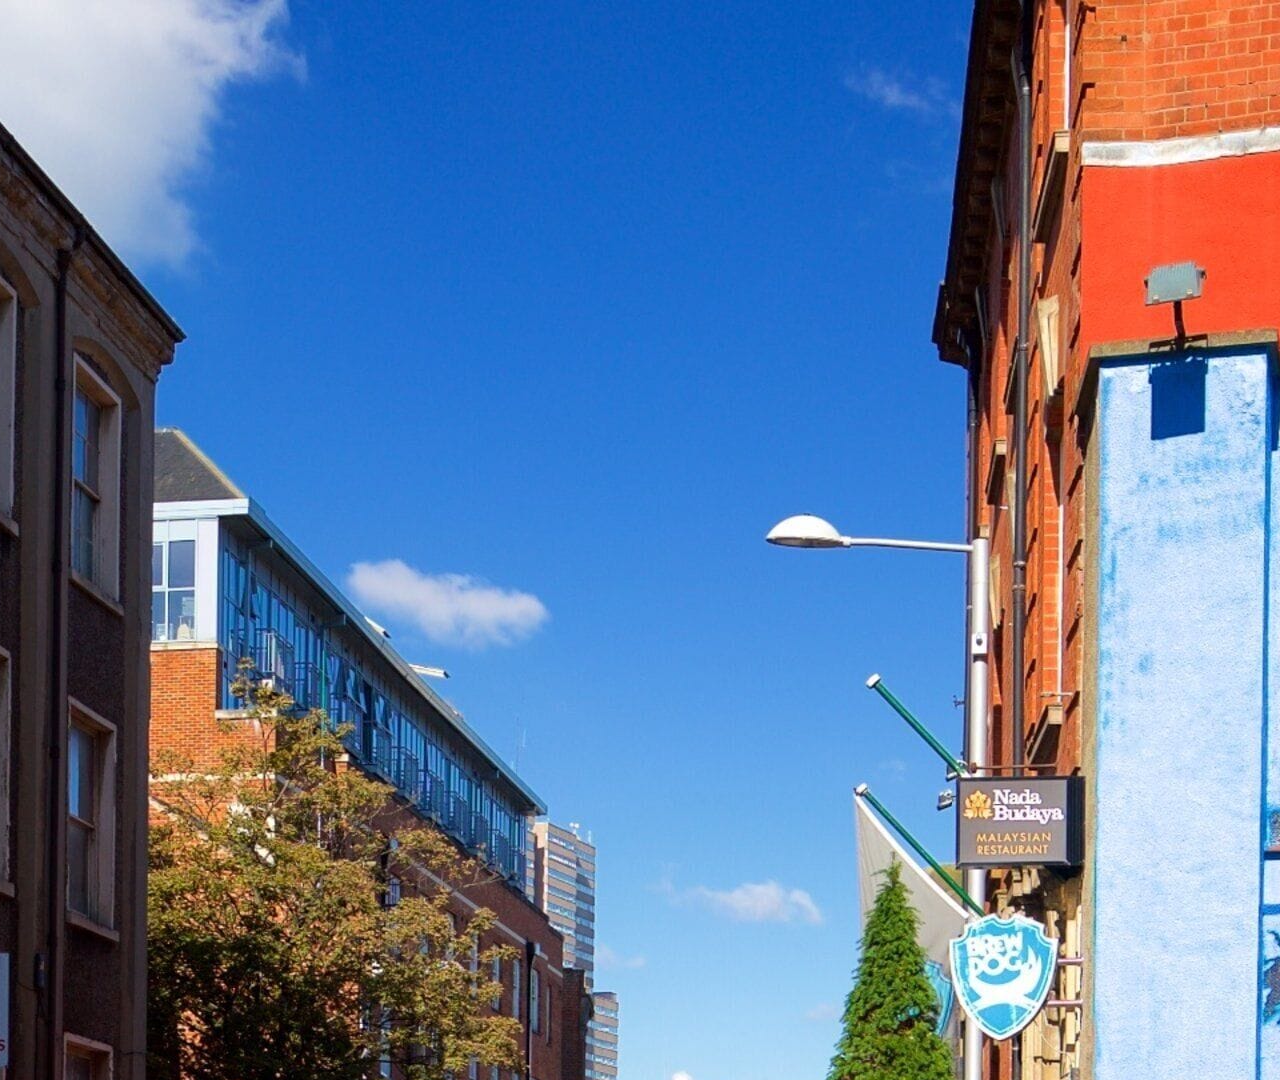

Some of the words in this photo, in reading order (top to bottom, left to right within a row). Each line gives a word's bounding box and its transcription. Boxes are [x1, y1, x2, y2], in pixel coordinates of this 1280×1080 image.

[992, 788, 1042, 805] Nada
[992, 804, 1064, 824] Budaya
[976, 832, 1052, 843] MALAYSIAN
[976, 844, 1049, 855] RESTAURANT
[966, 931, 1024, 958] BREW
[968, 953, 1027, 976] DOG
